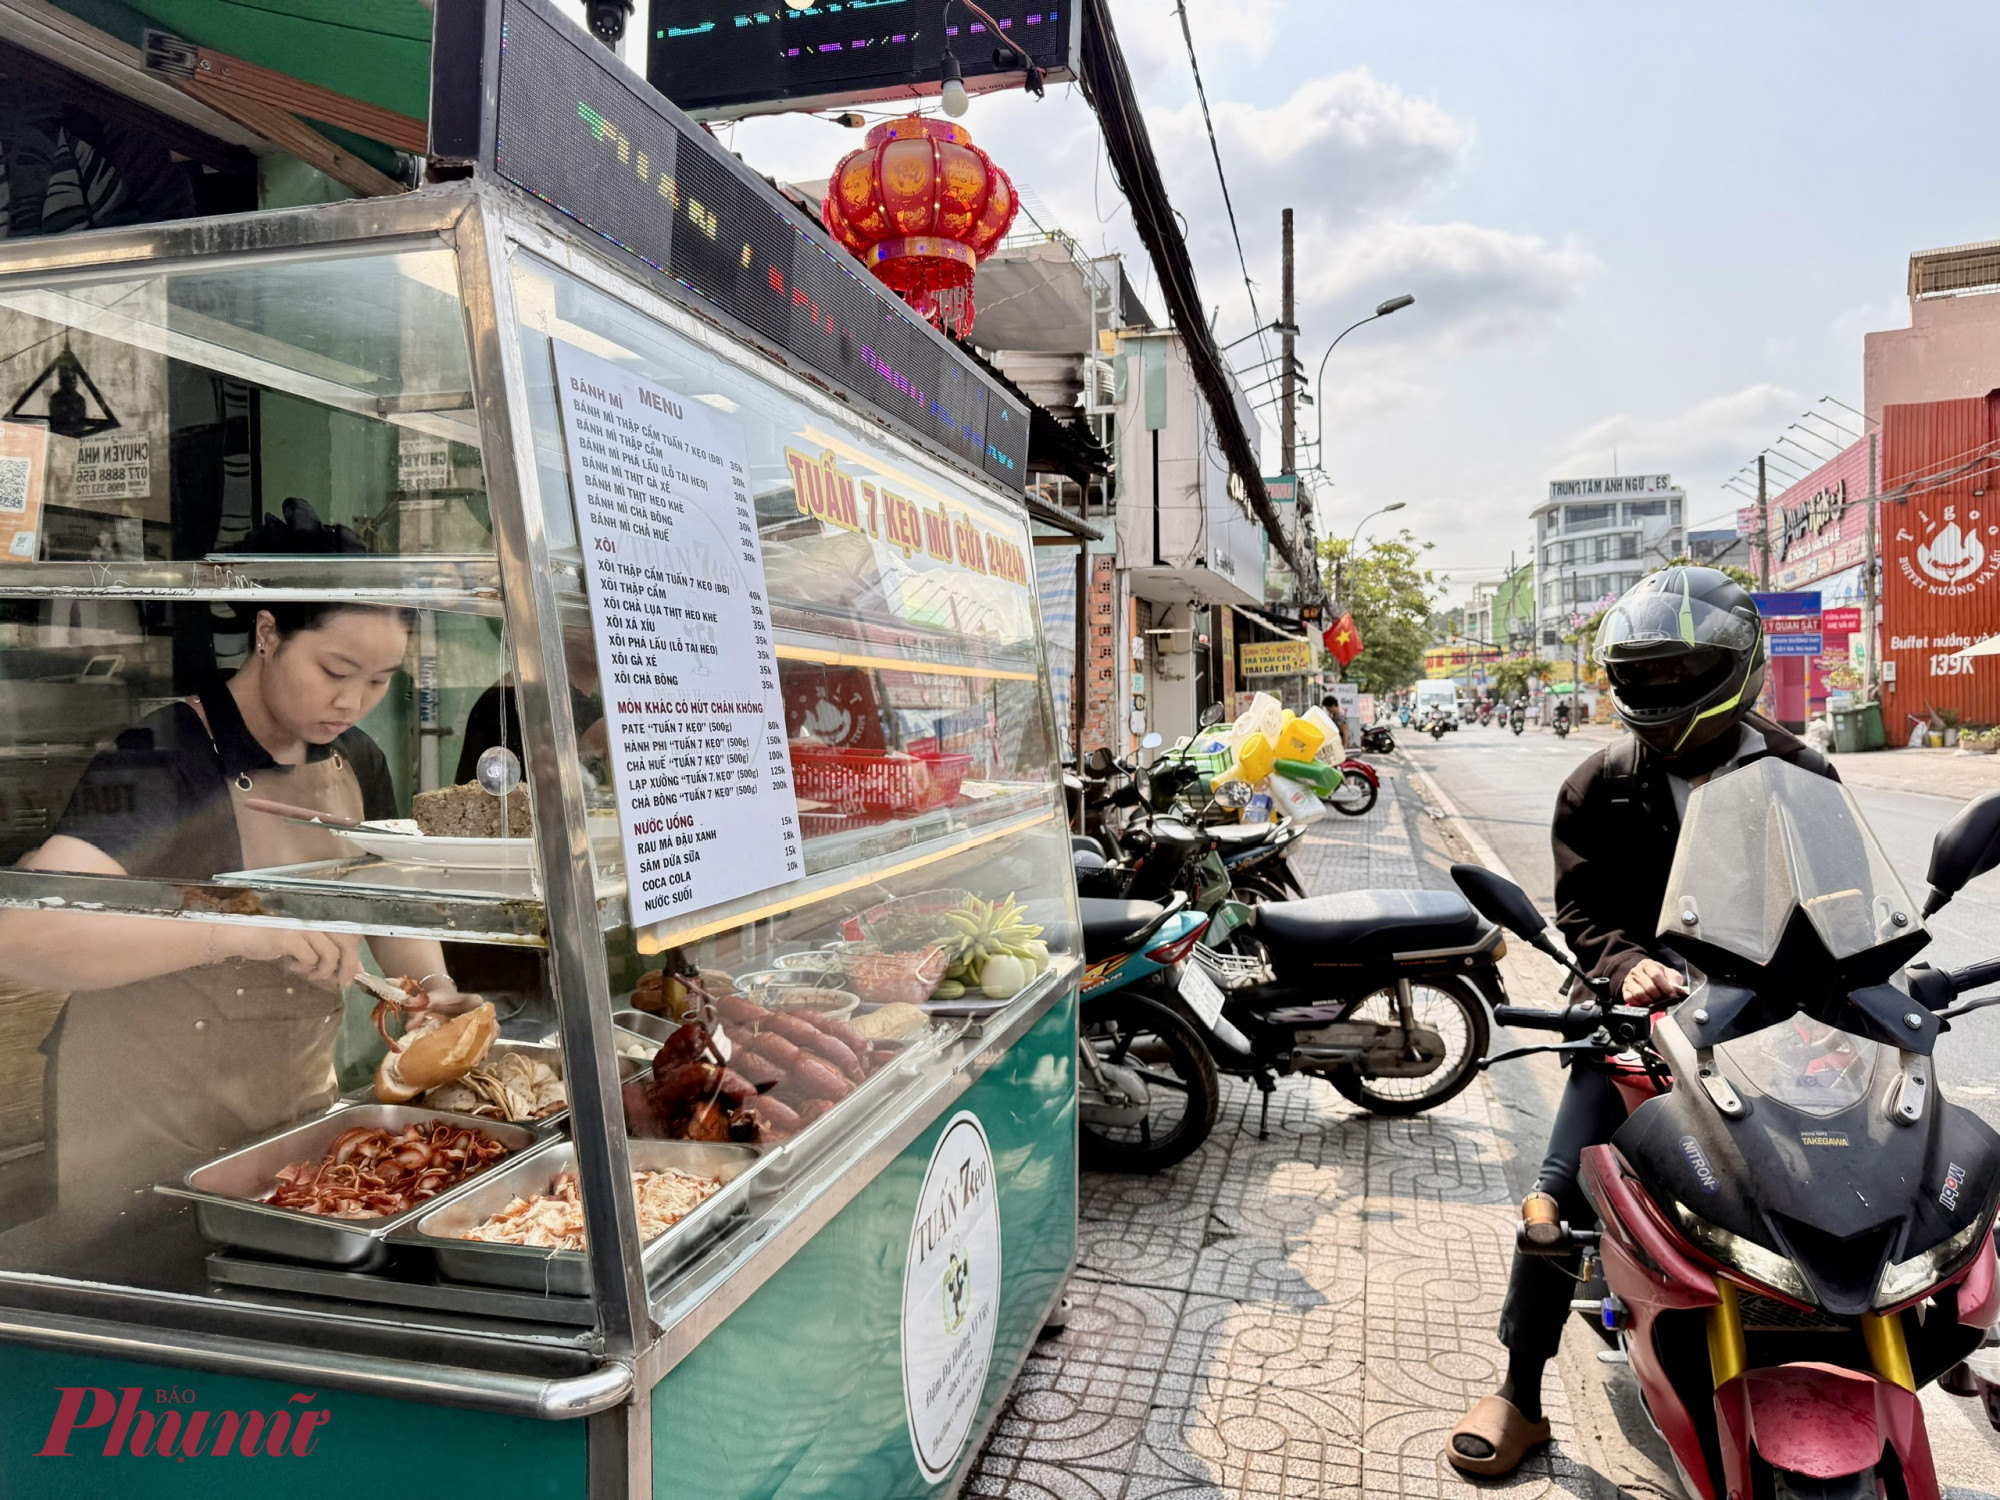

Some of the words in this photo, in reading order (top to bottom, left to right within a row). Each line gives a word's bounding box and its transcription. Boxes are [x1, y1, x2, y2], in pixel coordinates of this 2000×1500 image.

[570, 377, 606, 402] BÁNH
[608, 391, 623, 410] MÌ
[638, 387, 683, 420] MENU
[573, 398, 600, 419] BÁNH
[602, 410, 614, 424] MÌ
[615, 415, 640, 433] THẬP
[641, 424, 661, 442] CẨM
[661, 433, 683, 451] TUẤN
[683, 442, 689, 453] 7
[691, 445, 707, 460] KẸO
[708, 452, 723, 467] (ĐB)
[730, 461, 743, 474] 35k
[578, 436, 606, 456] BÁNH
[608, 447, 620, 460] MÌ
[621, 451, 640, 467] PHÁ
[641, 458, 659, 473] LẤU
[660, 464, 675, 478] (LỖ
[675, 470, 689, 483] TAI
[690, 475, 708, 491] HEO)
[734, 492, 747, 504] 30k
[581, 455, 609, 474] BÁNH
[610, 464, 623, 478] MÌ
[623, 469, 644, 486] THỊT
[646, 475, 658, 489] GÀ
[659, 480, 671, 494] XÉ
[736, 507, 749, 518] 30k
[1583, 478, 1602, 496] TÂM
[1604, 479, 1622, 492] ANH
[787, 451, 859, 529] TUẤN
[862, 486, 878, 535] 7
[882, 493, 923, 554] KẸO
[924, 503, 953, 561] MỞ
[955, 515, 986, 574] CỬA
[590, 512, 617, 528] BÁNH
[619, 518, 631, 532] MÌ
[632, 523, 651, 538] CHẢ
[652, 527, 670, 542] HUẾ
[743, 552, 756, 563] 30k
[593, 537, 616, 554] XÔI
[597, 558, 615, 573] XÔI
[616, 563, 642, 578] THẬP
[644, 566, 664, 582] CẨM
[665, 572, 688, 586] TUẤN
[689, 577, 694, 588] 7
[696, 579, 713, 591] KẸO
[714, 583, 730, 595] (ĐB)
[748, 590, 761, 600] 40k
[1899, 556, 1928, 590] BUFFET
[603, 596, 620, 610] XÔI
[622, 599, 642, 612] CHẢ
[663, 606, 682, 620] THỊT
[684, 609, 701, 620] HEO
[753, 620, 765, 630] 35k
[605, 614, 623, 629] XÔI
[625, 616, 638, 630] XÁ
[640, 618, 655, 632] XÍU
[755, 636, 767, 645] 35k
[1891, 635, 1929, 650] Buffet
[1930, 653, 1975, 677] 139K
[617, 700, 642, 714] MÓN
[644, 700, 673, 714] KHÁC
[674, 700, 688, 714] CÓ
[690, 700, 708, 714] HÚT
[710, 700, 734, 713] CHÂN
[735, 700, 763, 713] KHÔNG
[621, 723, 645, 734] PATE
[677, 722, 683, 733] 7
[708, 721, 732, 733] (500g)
[768, 722, 779, 730] 80k
[623, 739, 650, 753] HÀNH
[652, 740, 667, 751] PHI
[697, 738, 703, 749] 7
[726, 737, 749, 748] (500g)
[766, 736, 782, 744] 150k
[631, 794, 651, 809] CHÀ
[652, 792, 678, 807] BÔNG
[707, 789, 712, 799] 7
[735, 784, 757, 796] (500g)
[772, 781, 788, 790] 200k
[633, 818, 664, 836] NƯỚC
[665, 814, 694, 830] UỐNG
[637, 840, 656, 855] RAU
[658, 834, 673, 851] MÁ
[675, 832, 693, 847] ĐẬU
[695, 829, 717, 842] XANH
[782, 816, 792, 826] 15k
[639, 858, 661, 873] SÂM
[662, 853, 682, 868] DỨA
[683, 850, 700, 864] SỮA
[783, 831, 794, 840] 18k
[642, 876, 667, 892] COCA
[668, 871, 692, 885] COLA
[785, 846, 796, 856] 15k
[644, 894, 670, 911] NƯỚC
[671, 886, 692, 904] SUỐI
[787, 861, 798, 872] 10k
[1801, 1137, 1849, 1147] TAKEGAWA
[1682, 1141, 1716, 1187] NITRON
[1939, 1162, 1966, 1211] Mobil
